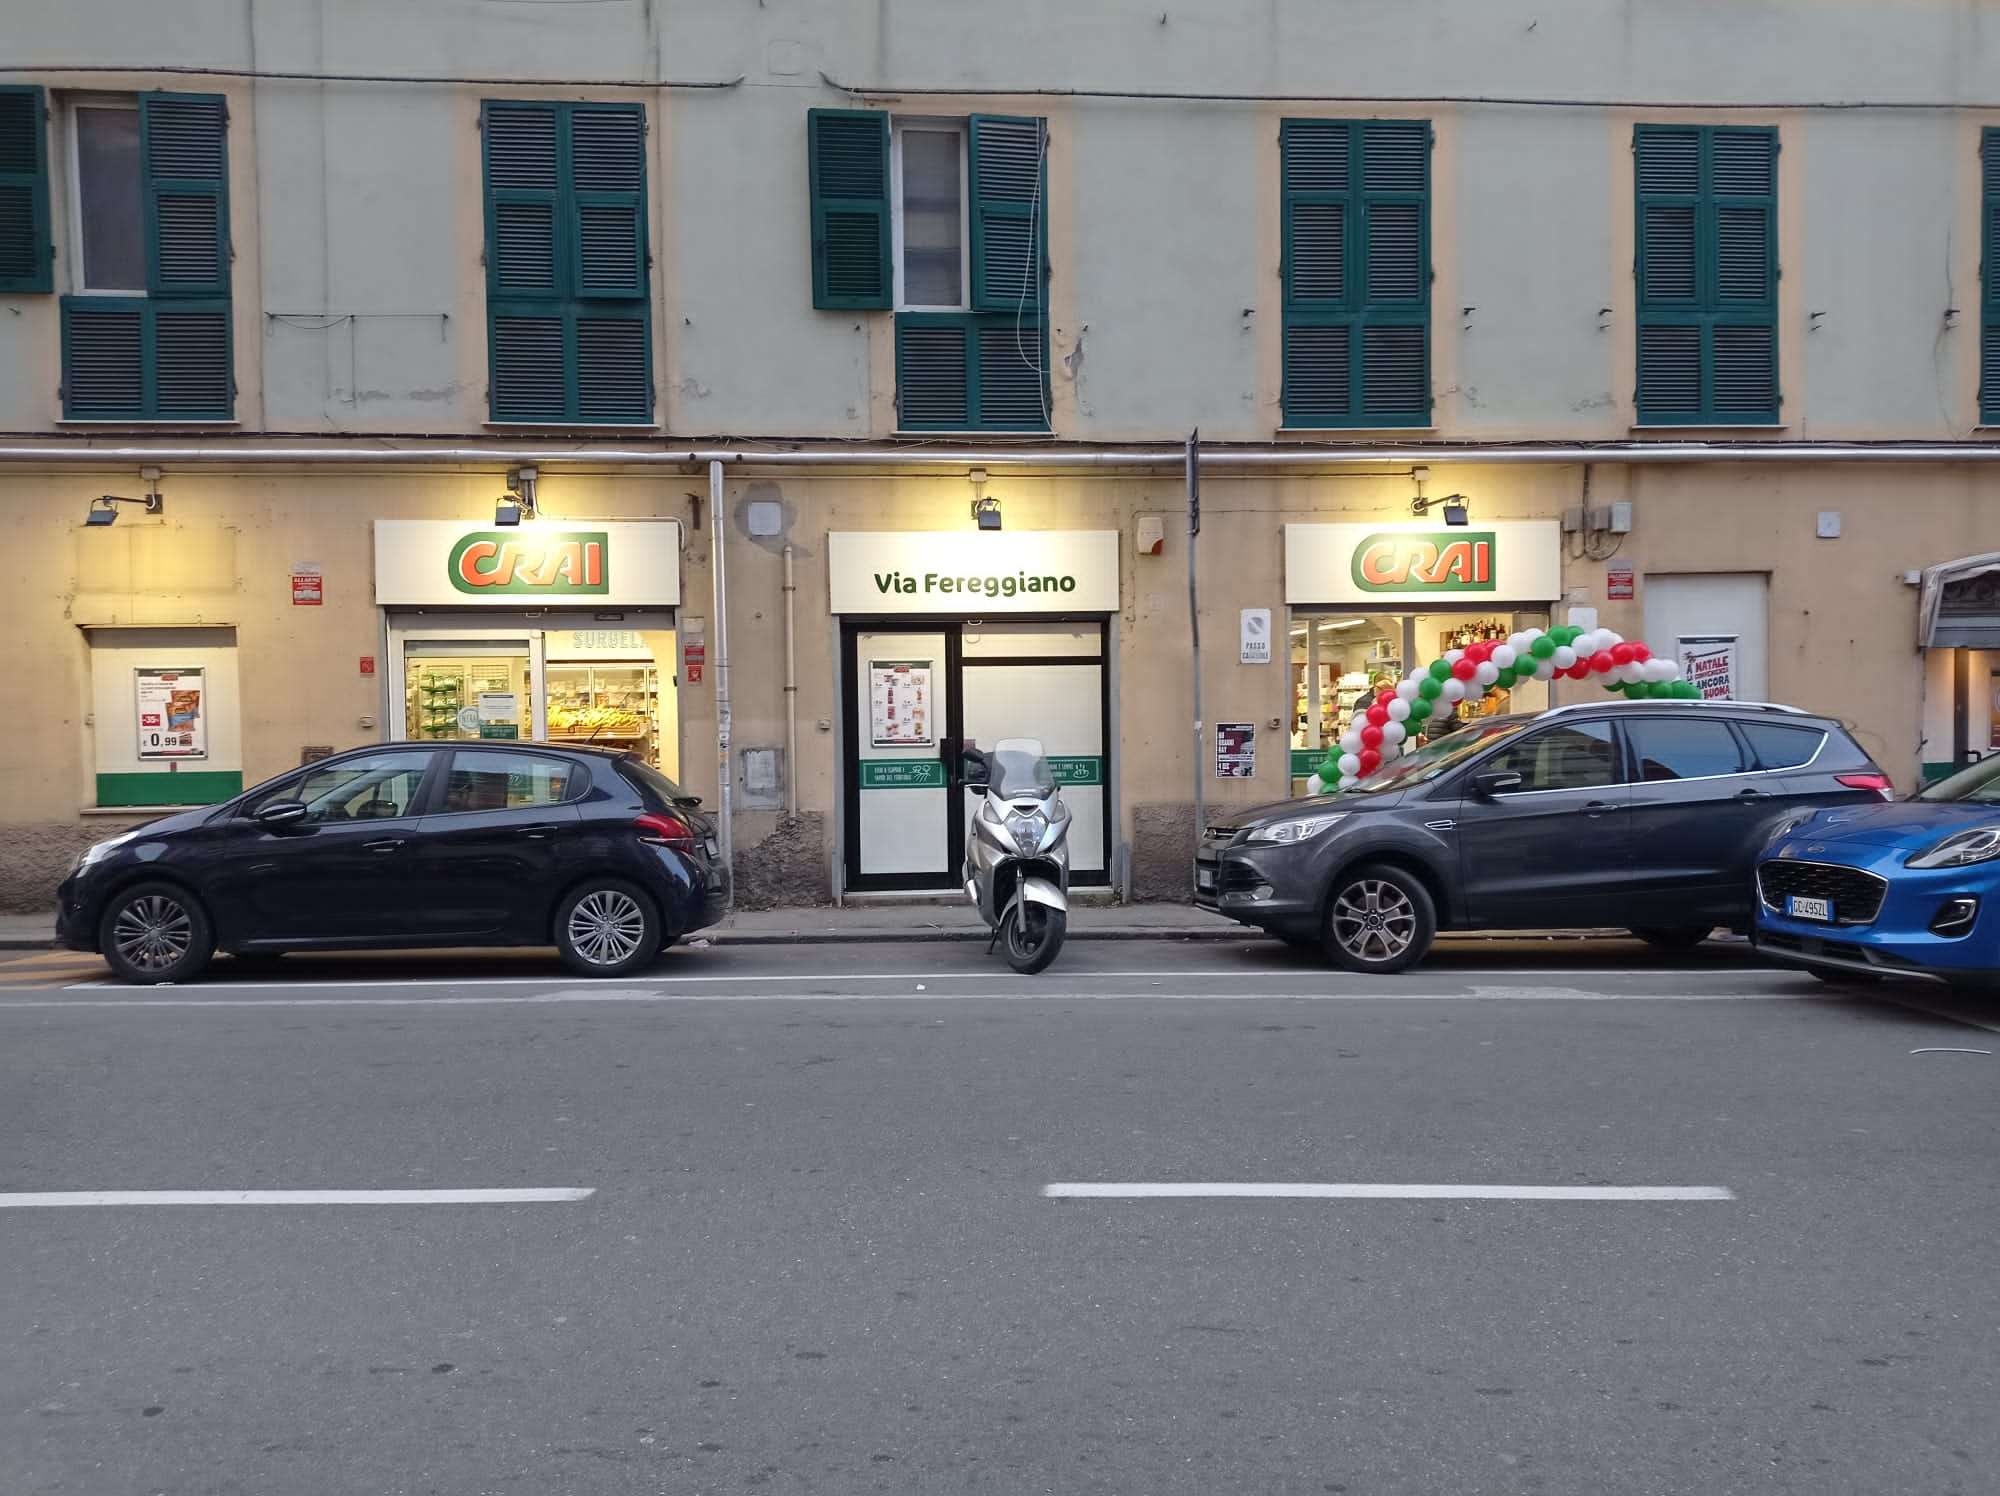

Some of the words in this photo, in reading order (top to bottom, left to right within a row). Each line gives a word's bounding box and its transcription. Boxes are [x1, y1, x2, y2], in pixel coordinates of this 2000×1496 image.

[459, 541, 602, 587] CRAI
[1360, 541, 1490, 585] CRAI
[873, 571, 917, 594] Via
[924, 571, 1076, 598] Fereggiano
[1695, 656, 1729, 673] NATALE
[1696, 674, 1729, 689] ANCORA
